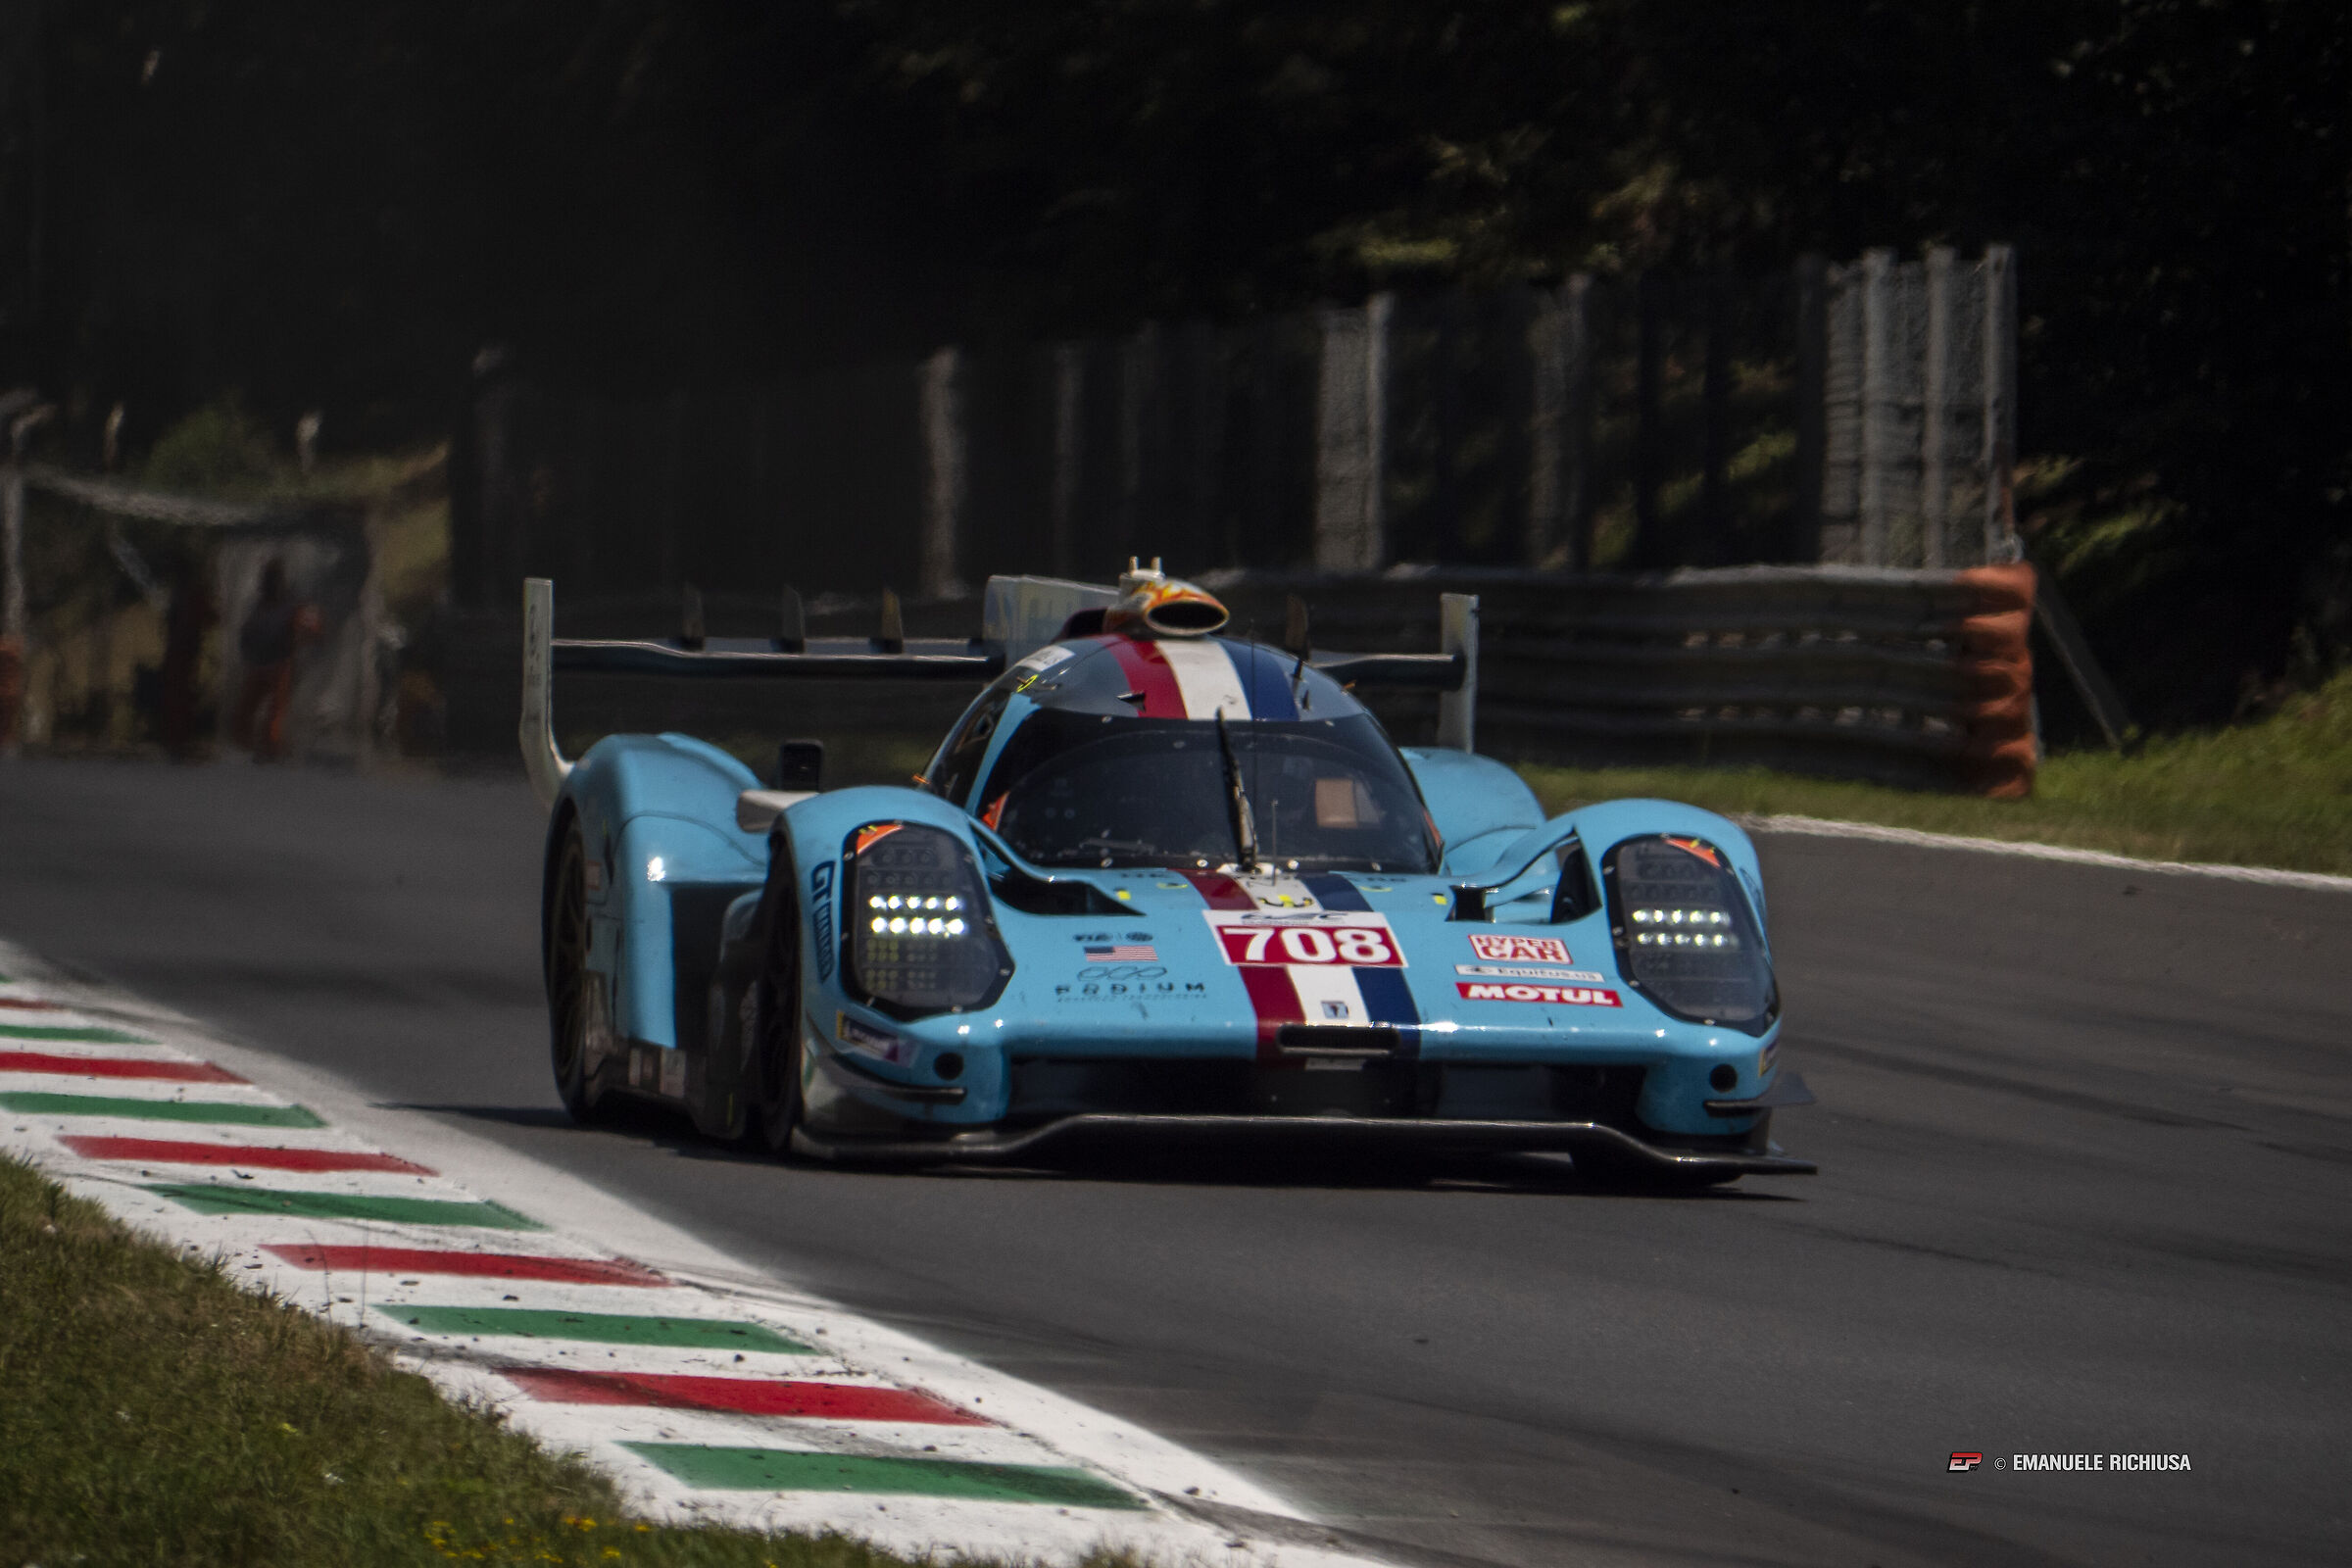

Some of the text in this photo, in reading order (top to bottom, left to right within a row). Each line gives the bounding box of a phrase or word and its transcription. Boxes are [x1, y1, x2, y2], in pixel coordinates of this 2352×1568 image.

[1223, 928, 1391, 962] 708
[1475, 936, 1557, 949] HYPER
[1481, 946, 1563, 960] CAR
[1054, 982, 1205, 996] PODIUM
[1468, 984, 1614, 1004] MOTUL
